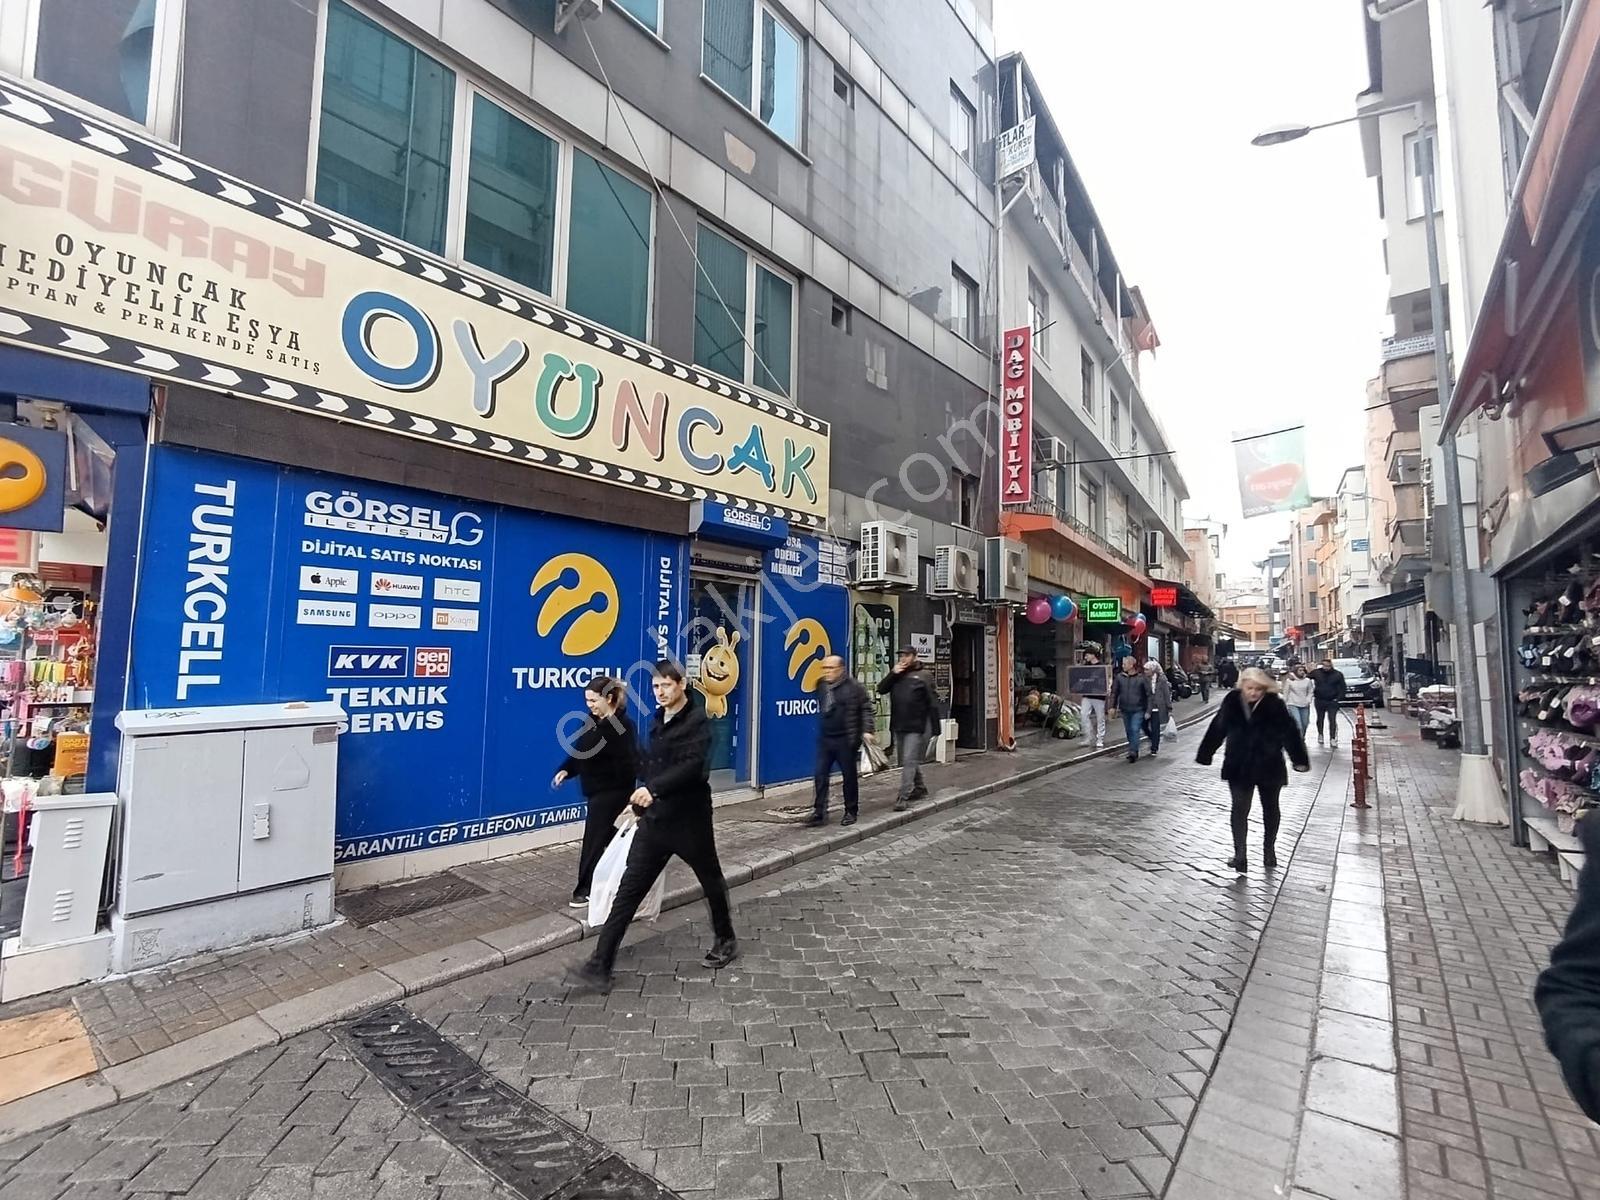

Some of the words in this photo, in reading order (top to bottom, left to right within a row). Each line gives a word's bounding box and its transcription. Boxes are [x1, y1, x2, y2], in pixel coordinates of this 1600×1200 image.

[0, 147, 326, 298] GÜRAY
[55, 233, 247, 311] OYUNCAK
[94, 301, 106, 315] &
[121, 309, 255, 355] PERAKENDE
[266, 343, 321, 375] SATIŞ
[227, 312, 302, 351] EŞYA
[341, 290, 818, 505] OYUNCAK
[1005, 385, 1025, 495] MOBİLYA
[305, 490, 449, 532] GÖRSEL
[302, 539, 367, 559] DİJİTAL
[371, 548, 416, 565] SATIŞ
[419, 553, 482, 571] NOKTASI
[176, 480, 236, 701] TURKCELL
[324, 576, 348, 587] Apple
[658, 556, 672, 620] DİJİTAL
[303, 608, 351, 617] SAMSUNG
[334, 654, 402, 669] KVK
[657, 624, 669, 662] SATI
[776, 699, 820, 716] TURKC
[428, 827, 459, 844] CEP
[462, 814, 536, 838] TELEFONU
